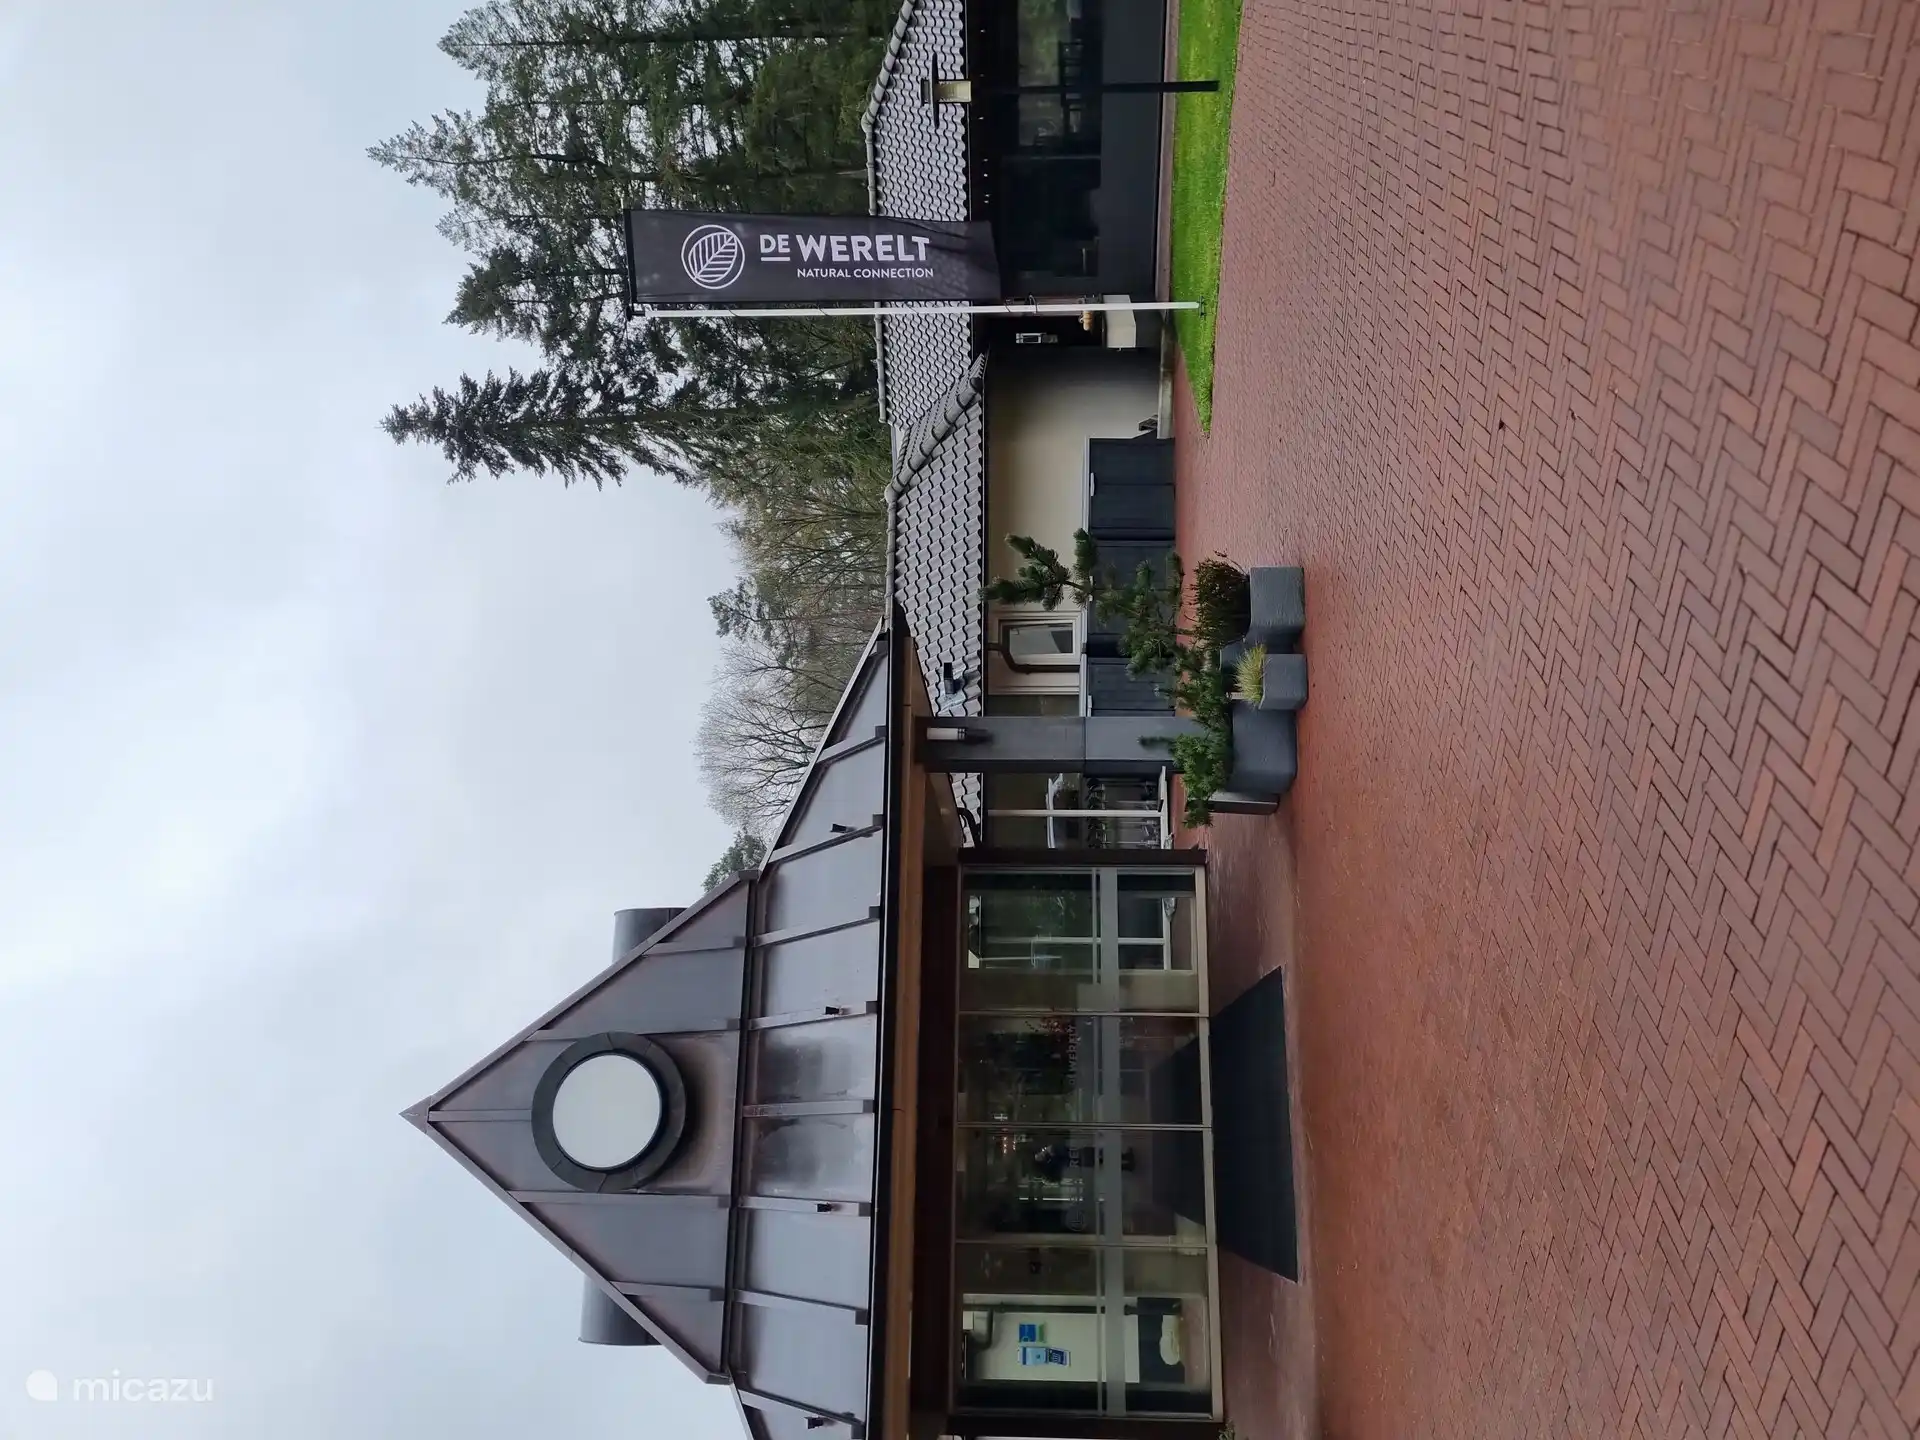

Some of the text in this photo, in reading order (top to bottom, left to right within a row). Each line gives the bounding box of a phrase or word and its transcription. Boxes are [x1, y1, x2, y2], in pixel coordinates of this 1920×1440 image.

[759, 234, 930, 262] DE WERELT
[797, 268, 933, 278] NATURAL CONNECTION
